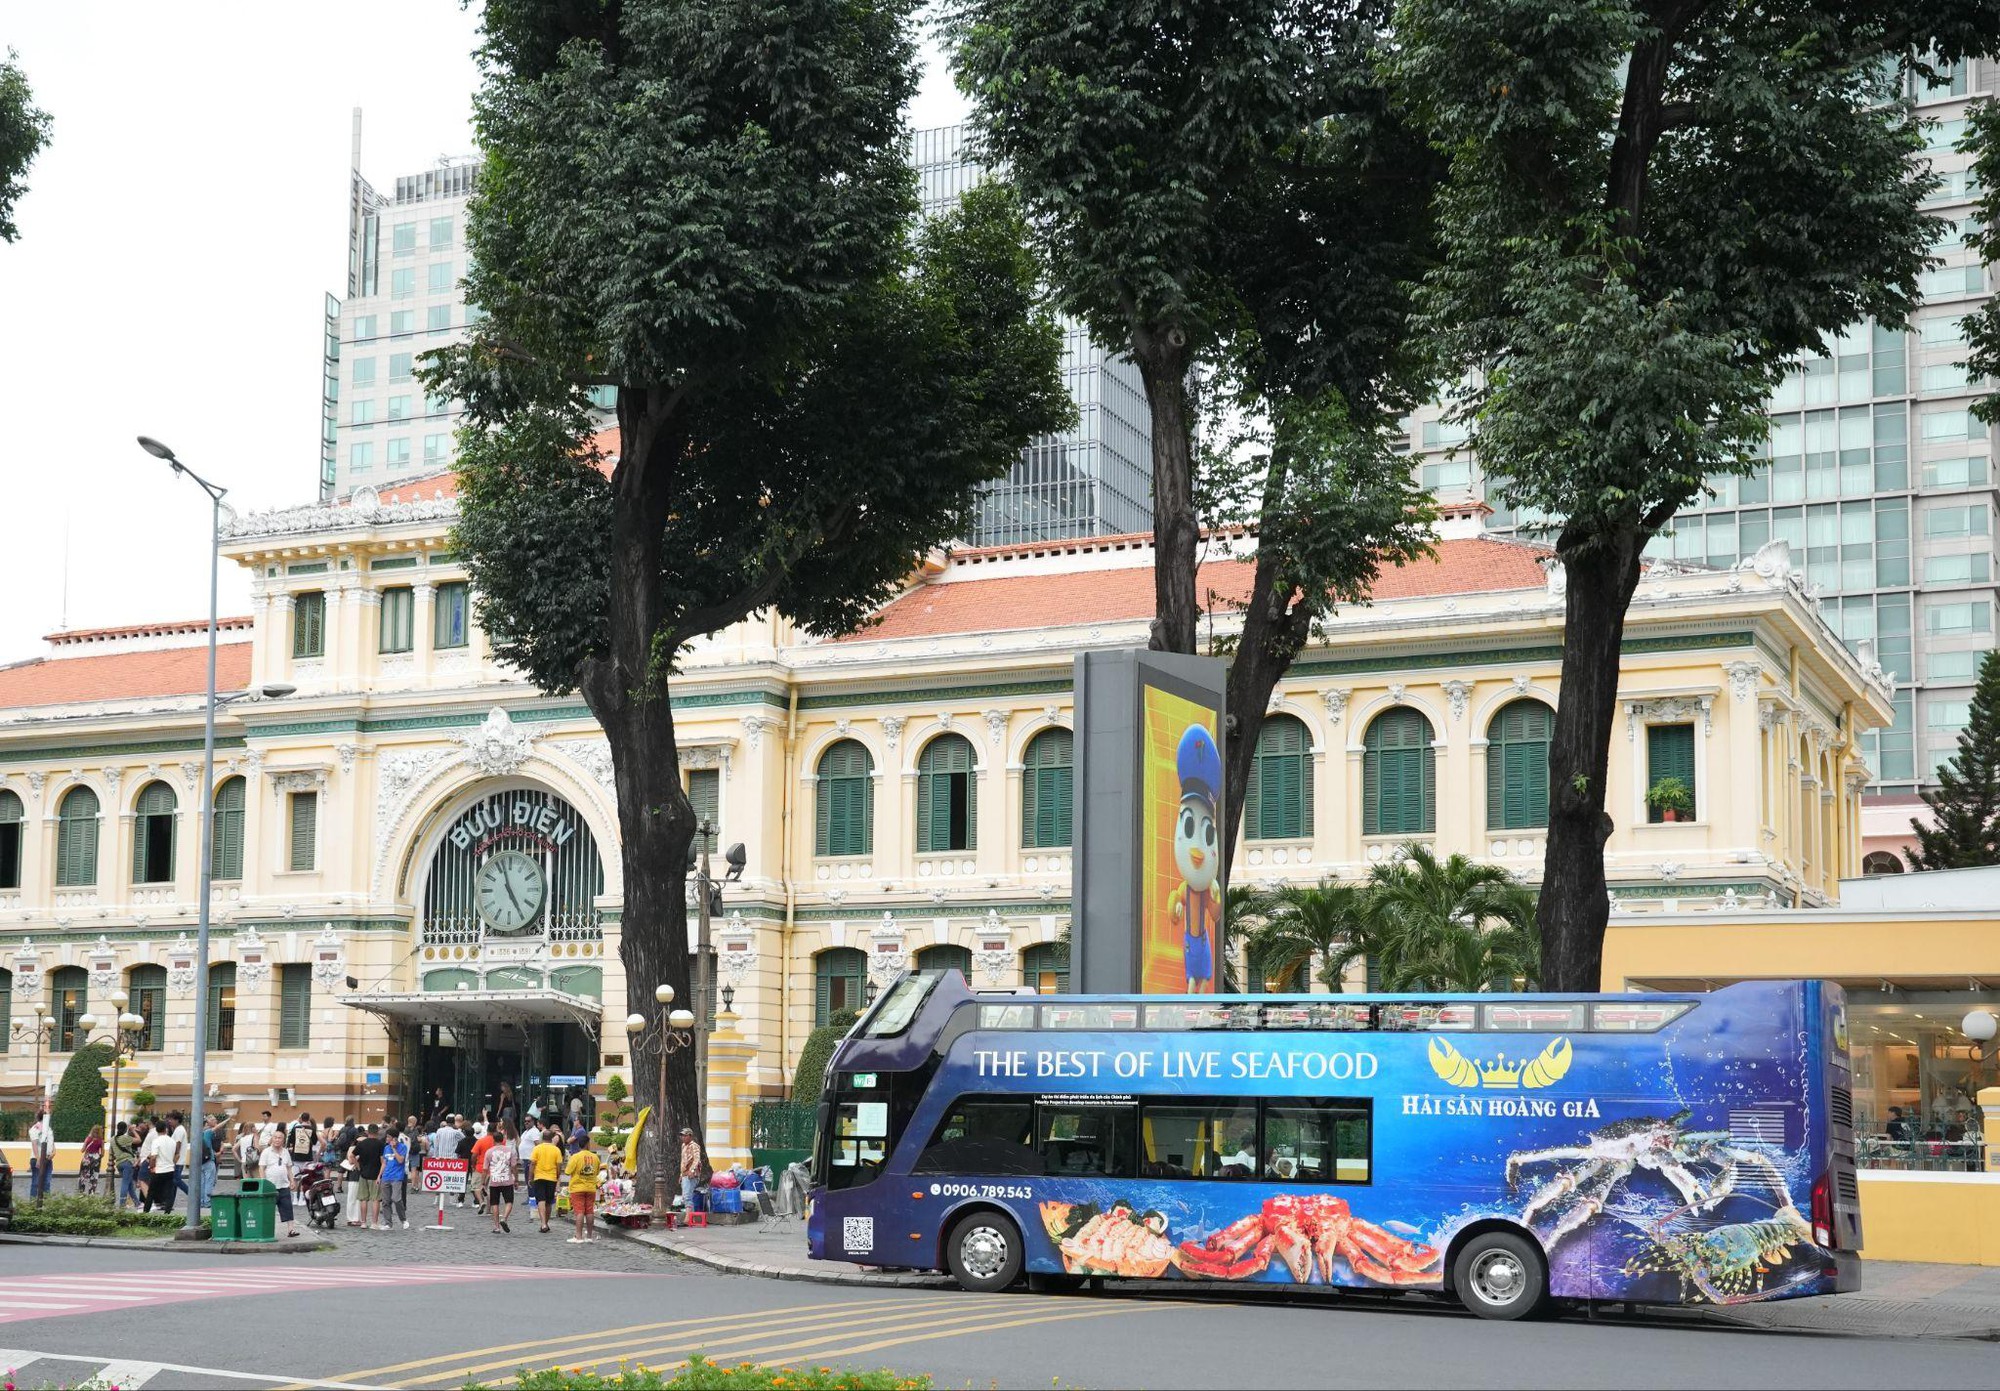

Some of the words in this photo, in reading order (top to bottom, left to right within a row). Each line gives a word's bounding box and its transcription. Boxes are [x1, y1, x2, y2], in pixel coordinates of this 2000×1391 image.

[512, 801, 574, 845] ĐIỆN
[974, 1051, 1028, 1077] THE
[1037, 1051, 1105, 1077] BEST
[1114, 1051, 1156, 1078] OF
[1163, 1052, 1222, 1078] LIVE
[1230, 1051, 1378, 1080] SEAFOOD
[1402, 1093, 1442, 1115] HẢI
[1446, 1094, 1483, 1116] SẢN
[1488, 1096, 1557, 1118] HOÀNG
[1562, 1098, 1601, 1118] GIA
[942, 1184, 1032, 1199] 0906.789.543
